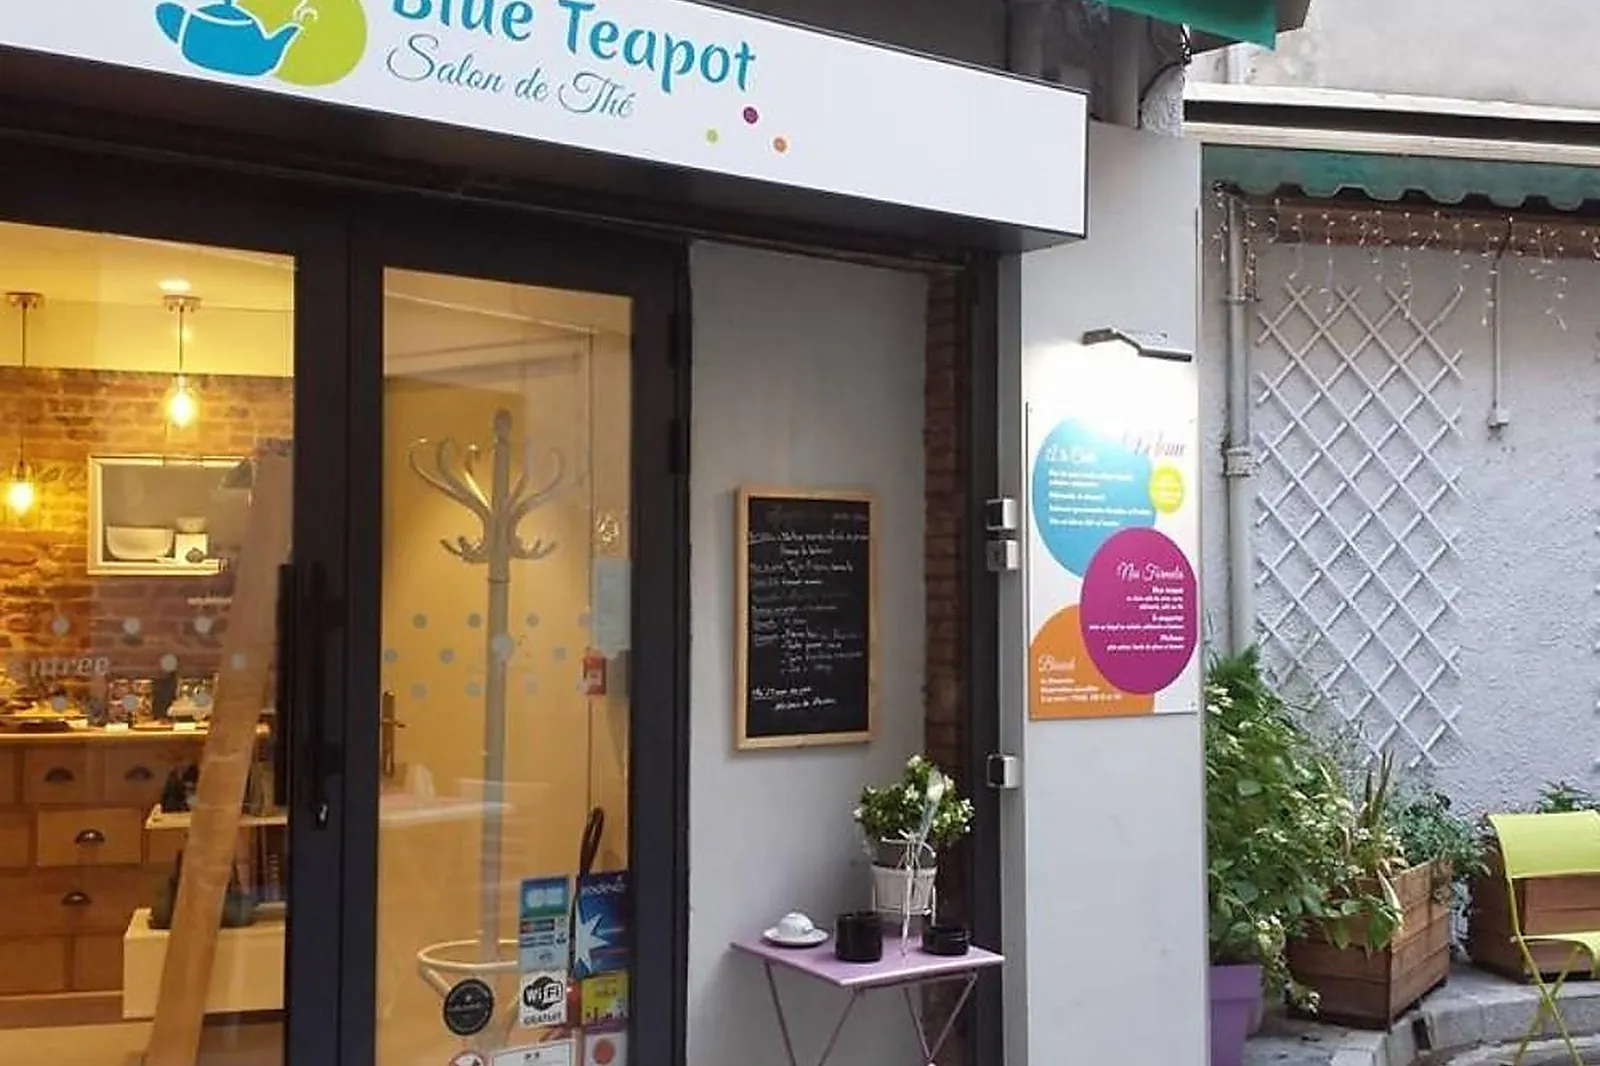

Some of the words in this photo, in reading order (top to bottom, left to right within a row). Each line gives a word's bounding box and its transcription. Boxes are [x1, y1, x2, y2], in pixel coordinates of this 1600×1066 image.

[386, 33, 503, 93] Salon
[514, 67, 549, 101] de
[558, 72, 637, 118] Thé
[558, 0, 757, 94] Teapot
